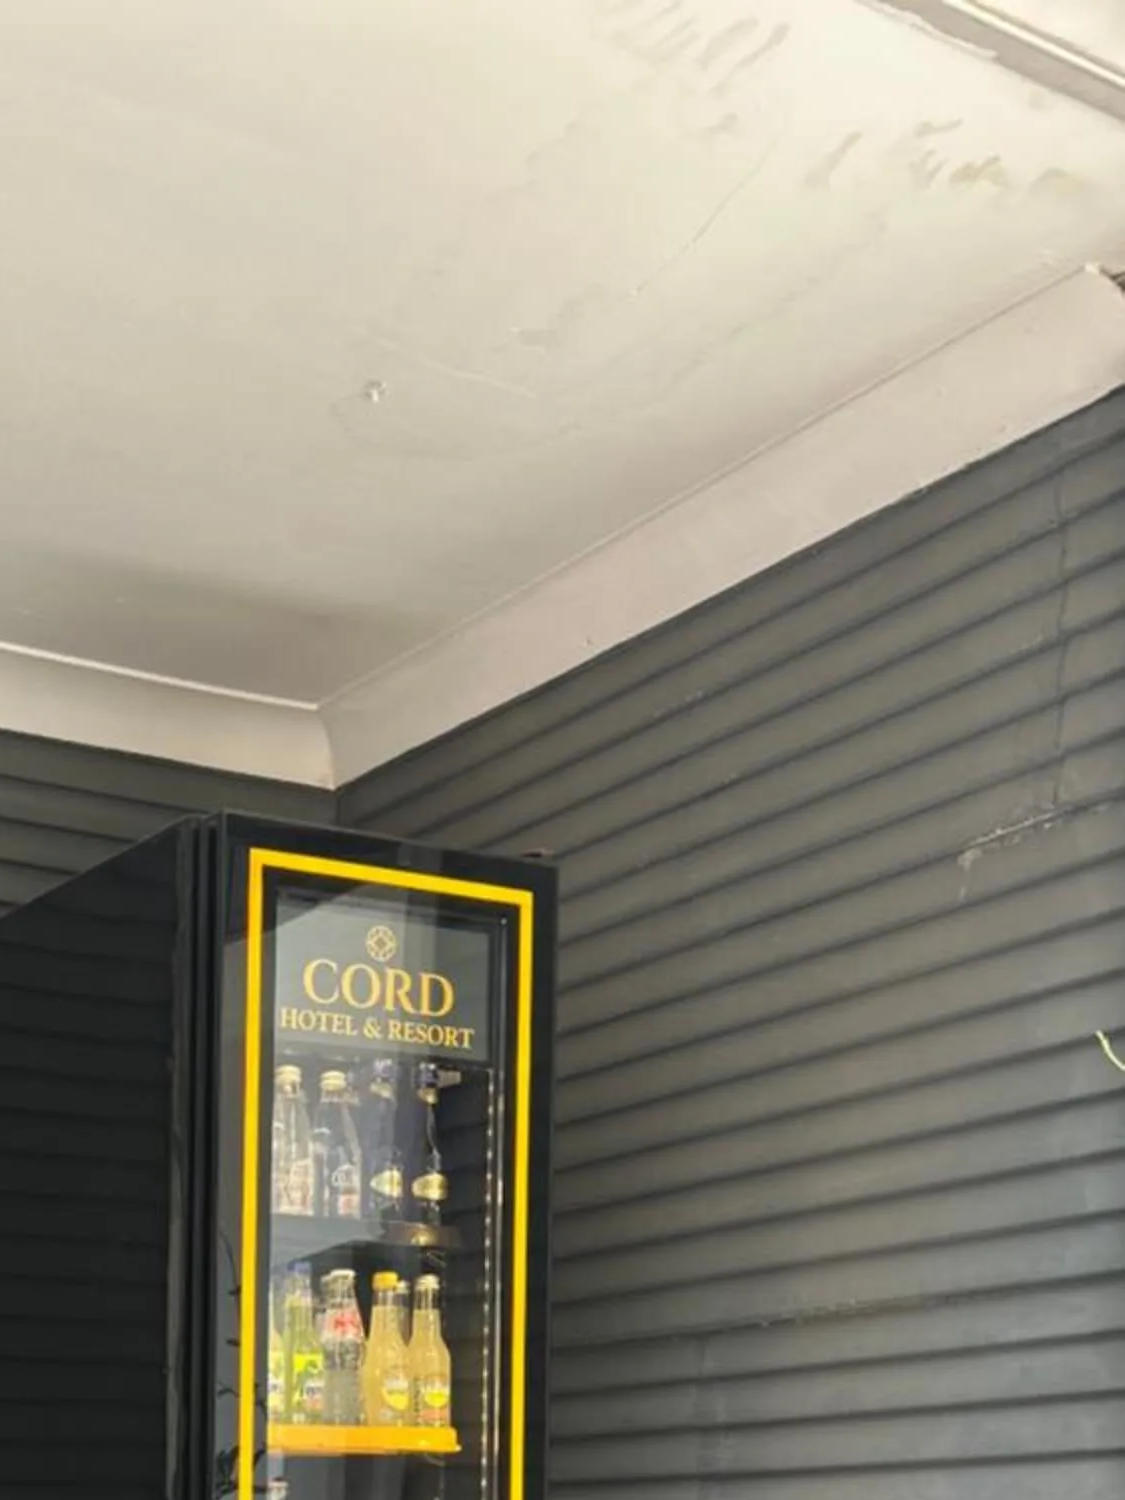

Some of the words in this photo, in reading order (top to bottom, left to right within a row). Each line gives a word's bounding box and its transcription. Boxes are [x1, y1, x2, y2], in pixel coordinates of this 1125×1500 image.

[303, 958, 455, 1018] CORD
[280, 1006, 359, 1037] HOTEL
[363, 1016, 383, 1040] &
[388, 1019, 475, 1049] RESORT
